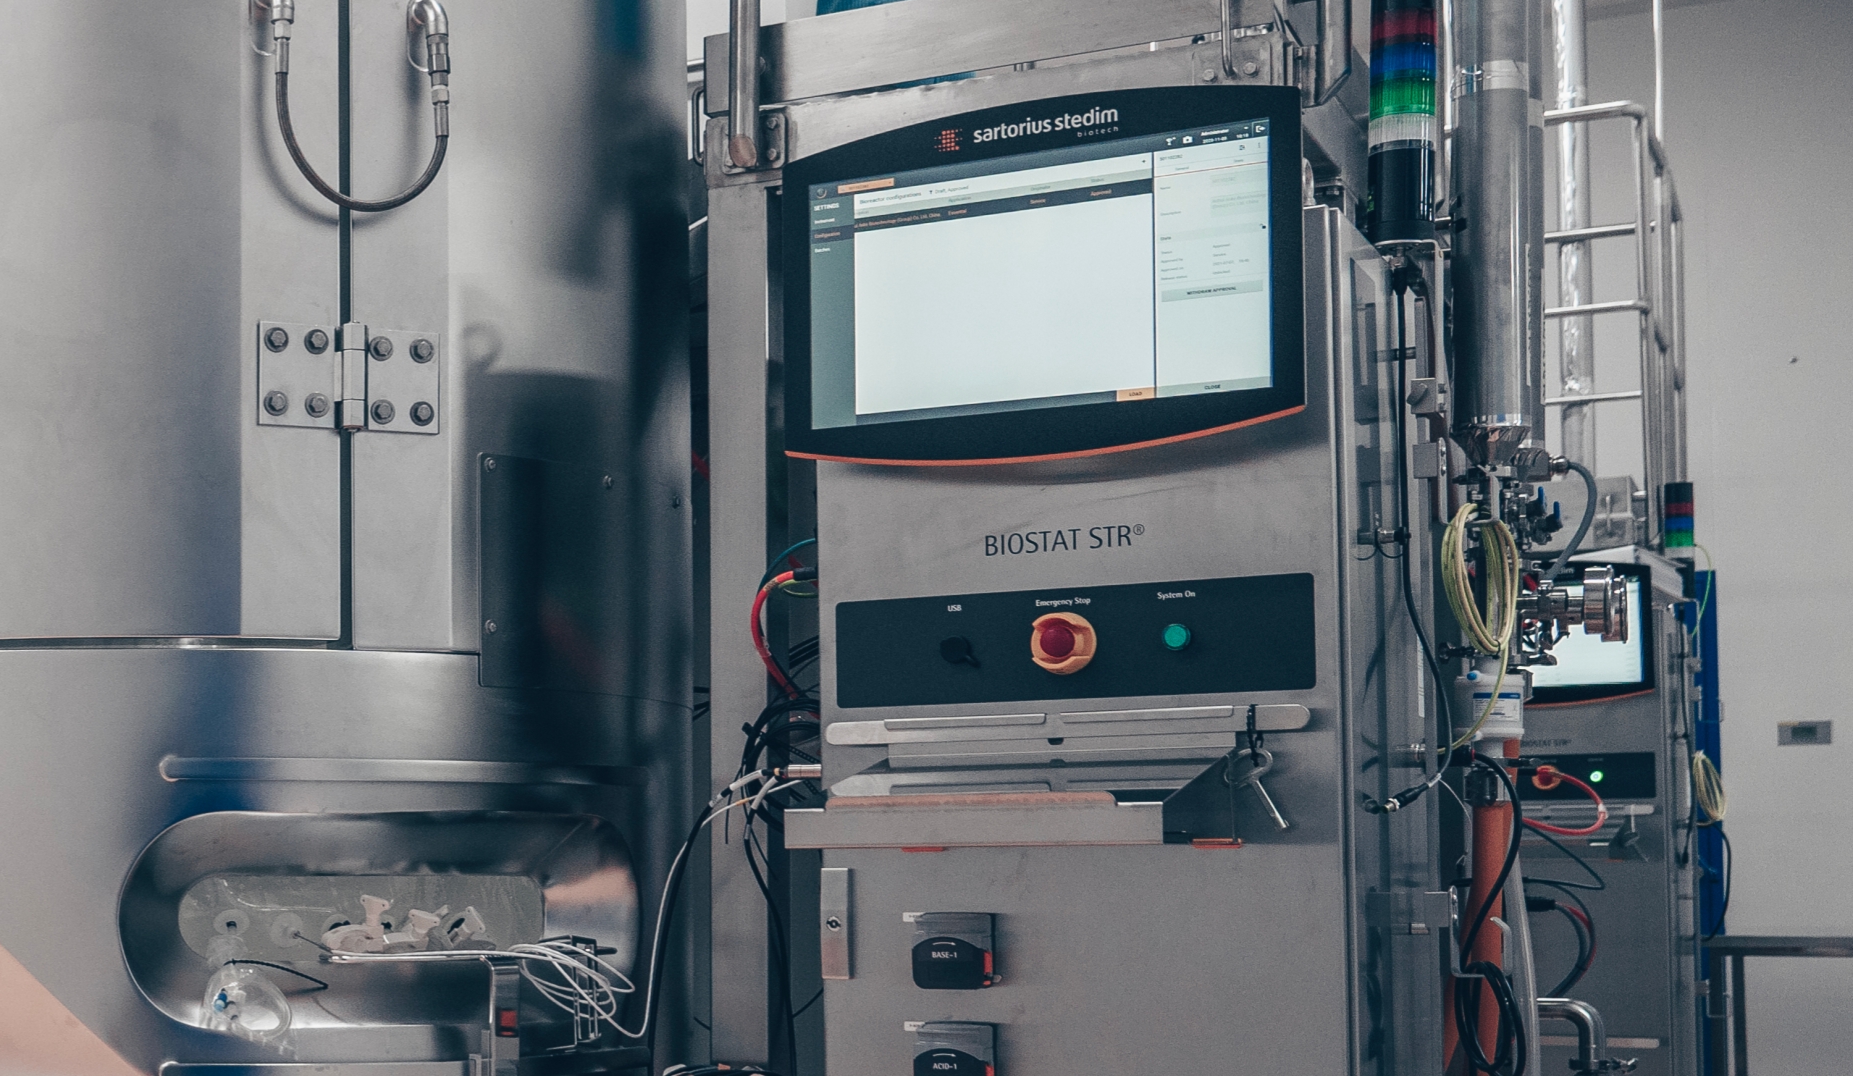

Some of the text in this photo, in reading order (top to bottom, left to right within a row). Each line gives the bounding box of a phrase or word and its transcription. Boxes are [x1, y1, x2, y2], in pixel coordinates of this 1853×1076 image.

[973, 106, 1119, 143] sartorius stedim
[1077, 126, 1119, 138] biotech
[859, 196, 885, 205] Bioreactor
[886, 191, 922, 202] configurations
[813, 202, 840, 211] SETTINGS
[1186, 288, 1212, 296] WITHDRAW
[984, 528, 1081, 557] BIOSTAT
[1157, 589, 1196, 600] System On
[1035, 596, 1091, 608] Emergency Stop
[947, 604, 962, 612] USB
[931, 951, 958, 959] BASE-1
[932, 1062, 958, 1070] ACID-1
